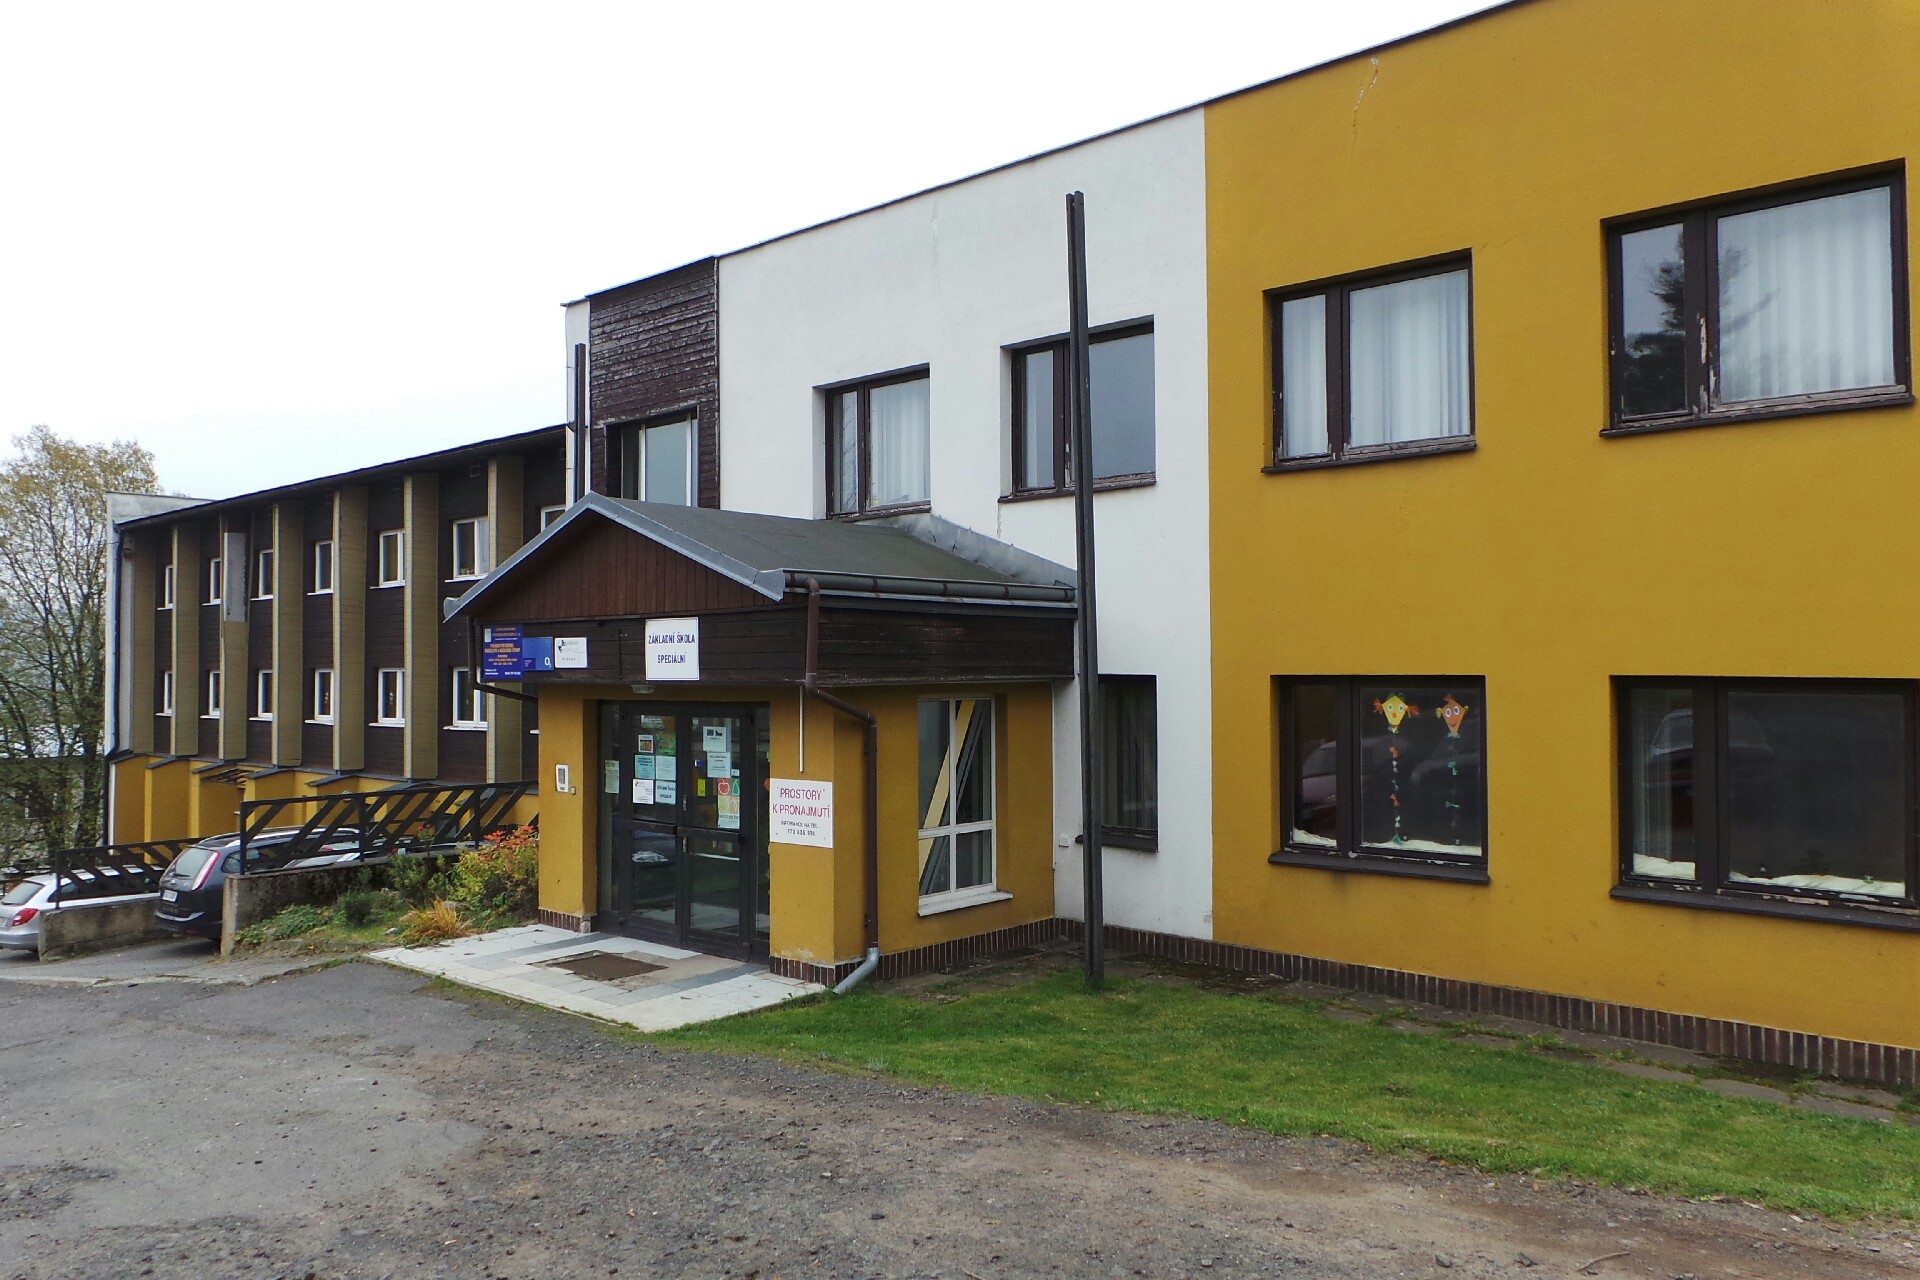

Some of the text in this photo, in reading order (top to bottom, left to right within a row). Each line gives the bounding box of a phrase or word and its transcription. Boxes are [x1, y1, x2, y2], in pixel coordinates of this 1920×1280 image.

[648, 632, 695, 644] ZÁKLADNÍ ŠKOLA
[658, 652, 687, 663] SPECIÁLNÍ
[780, 788, 821, 800] PROSTORY
[773, 804, 830, 818] K PRONAJMUTÍ
